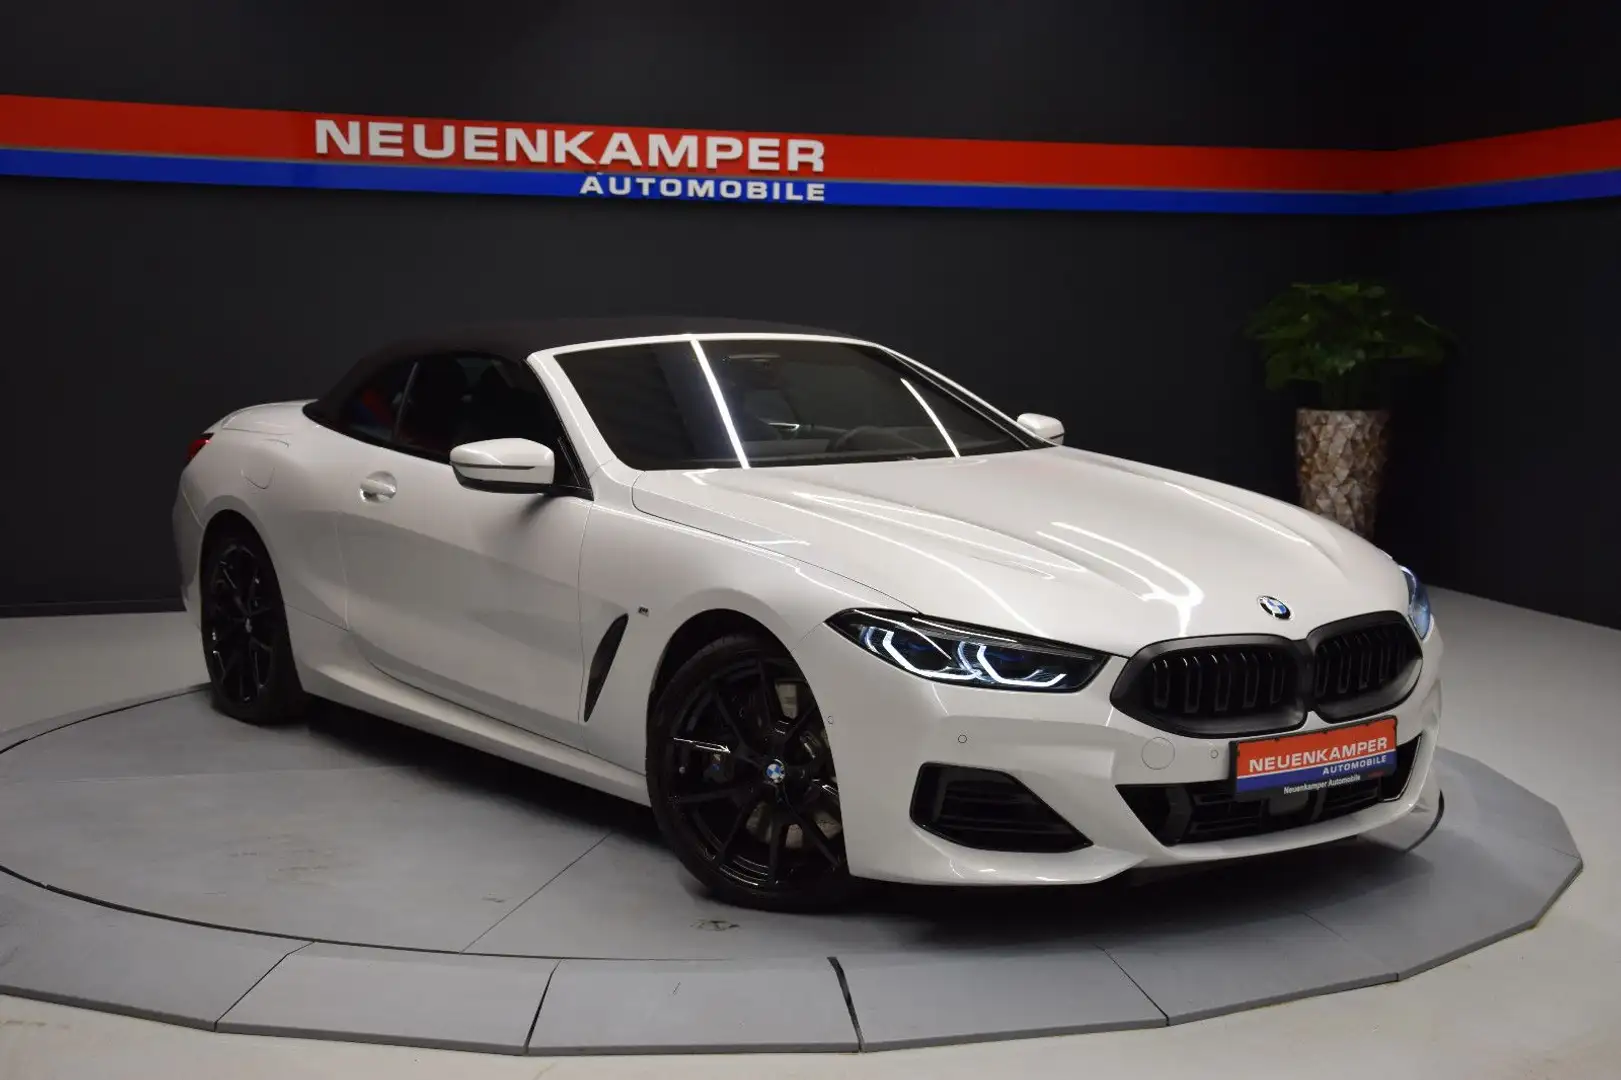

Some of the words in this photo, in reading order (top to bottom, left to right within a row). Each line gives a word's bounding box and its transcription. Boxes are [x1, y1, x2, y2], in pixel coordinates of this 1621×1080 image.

[314, 119, 826, 173] NEUENKAMPER
[579, 175, 826, 202] AUTOMOBILE
[1248, 736, 1388, 773] NEUENKAMPER
[1322, 755, 1387, 776] AUTOMOBILE
[1283, 780, 1328, 795] Neuenkamper
[1328, 774, 1361, 787] Automobile
